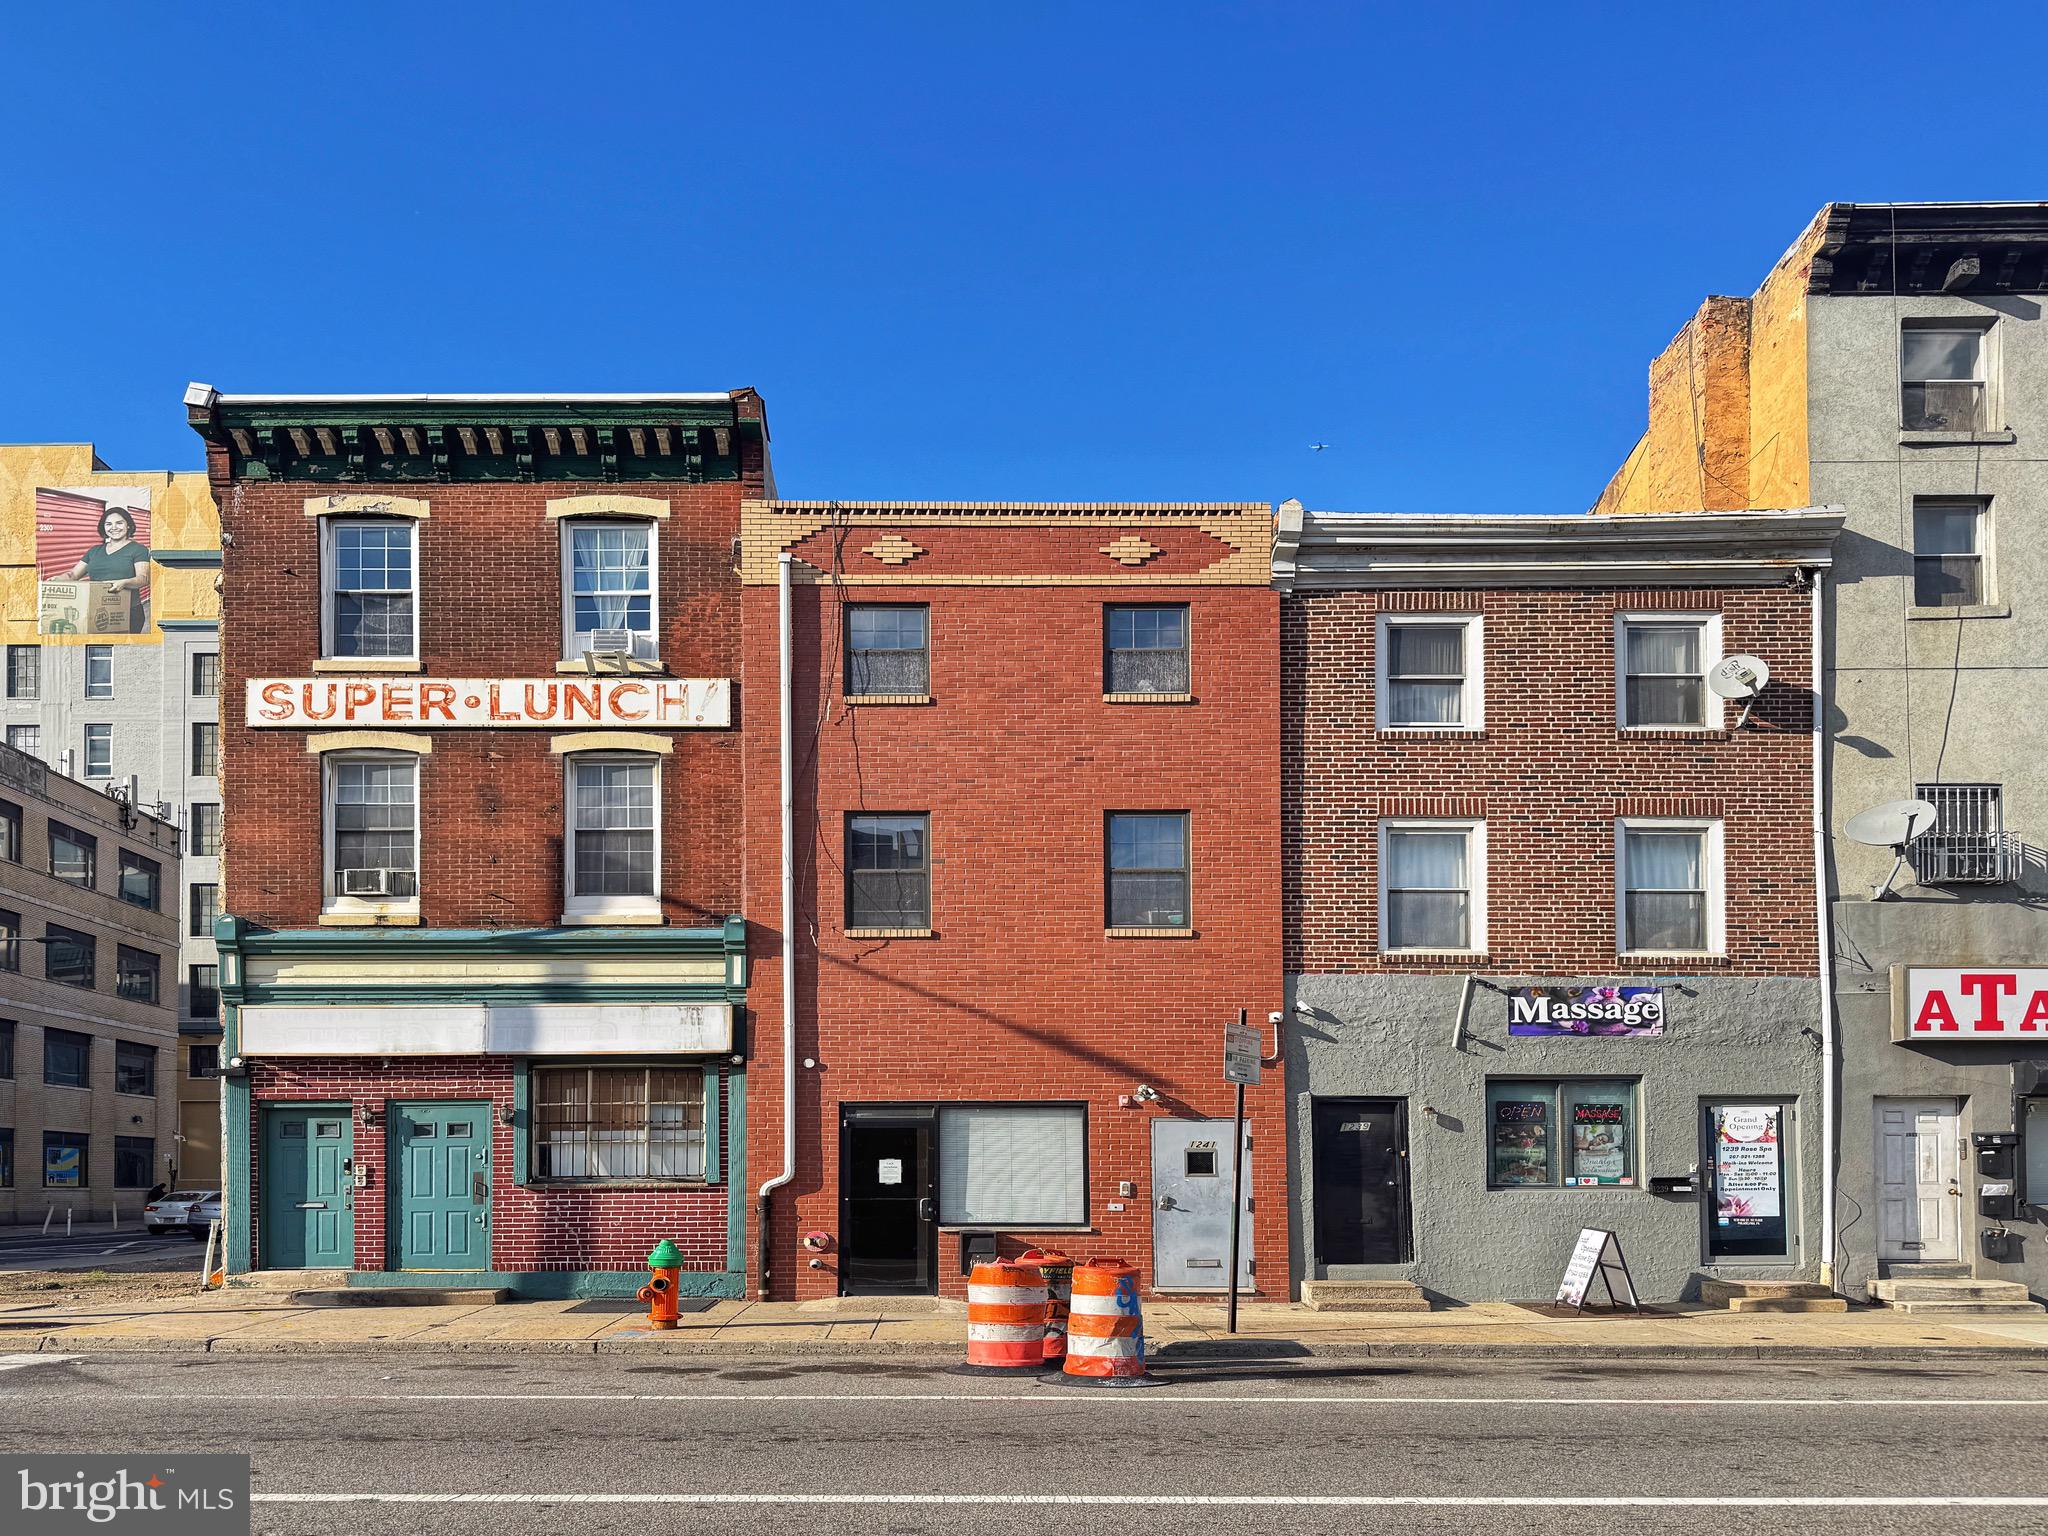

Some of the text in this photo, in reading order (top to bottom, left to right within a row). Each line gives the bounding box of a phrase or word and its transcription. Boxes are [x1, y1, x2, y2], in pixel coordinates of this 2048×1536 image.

[258, 682, 458, 720] SUPER
[1510, 996, 1660, 1025] Massage
[1914, 974, 2048, 1031] ATA
[1500, 1106, 1543, 1118] OPEN
[1576, 1109, 1622, 1119] MASSAGE
